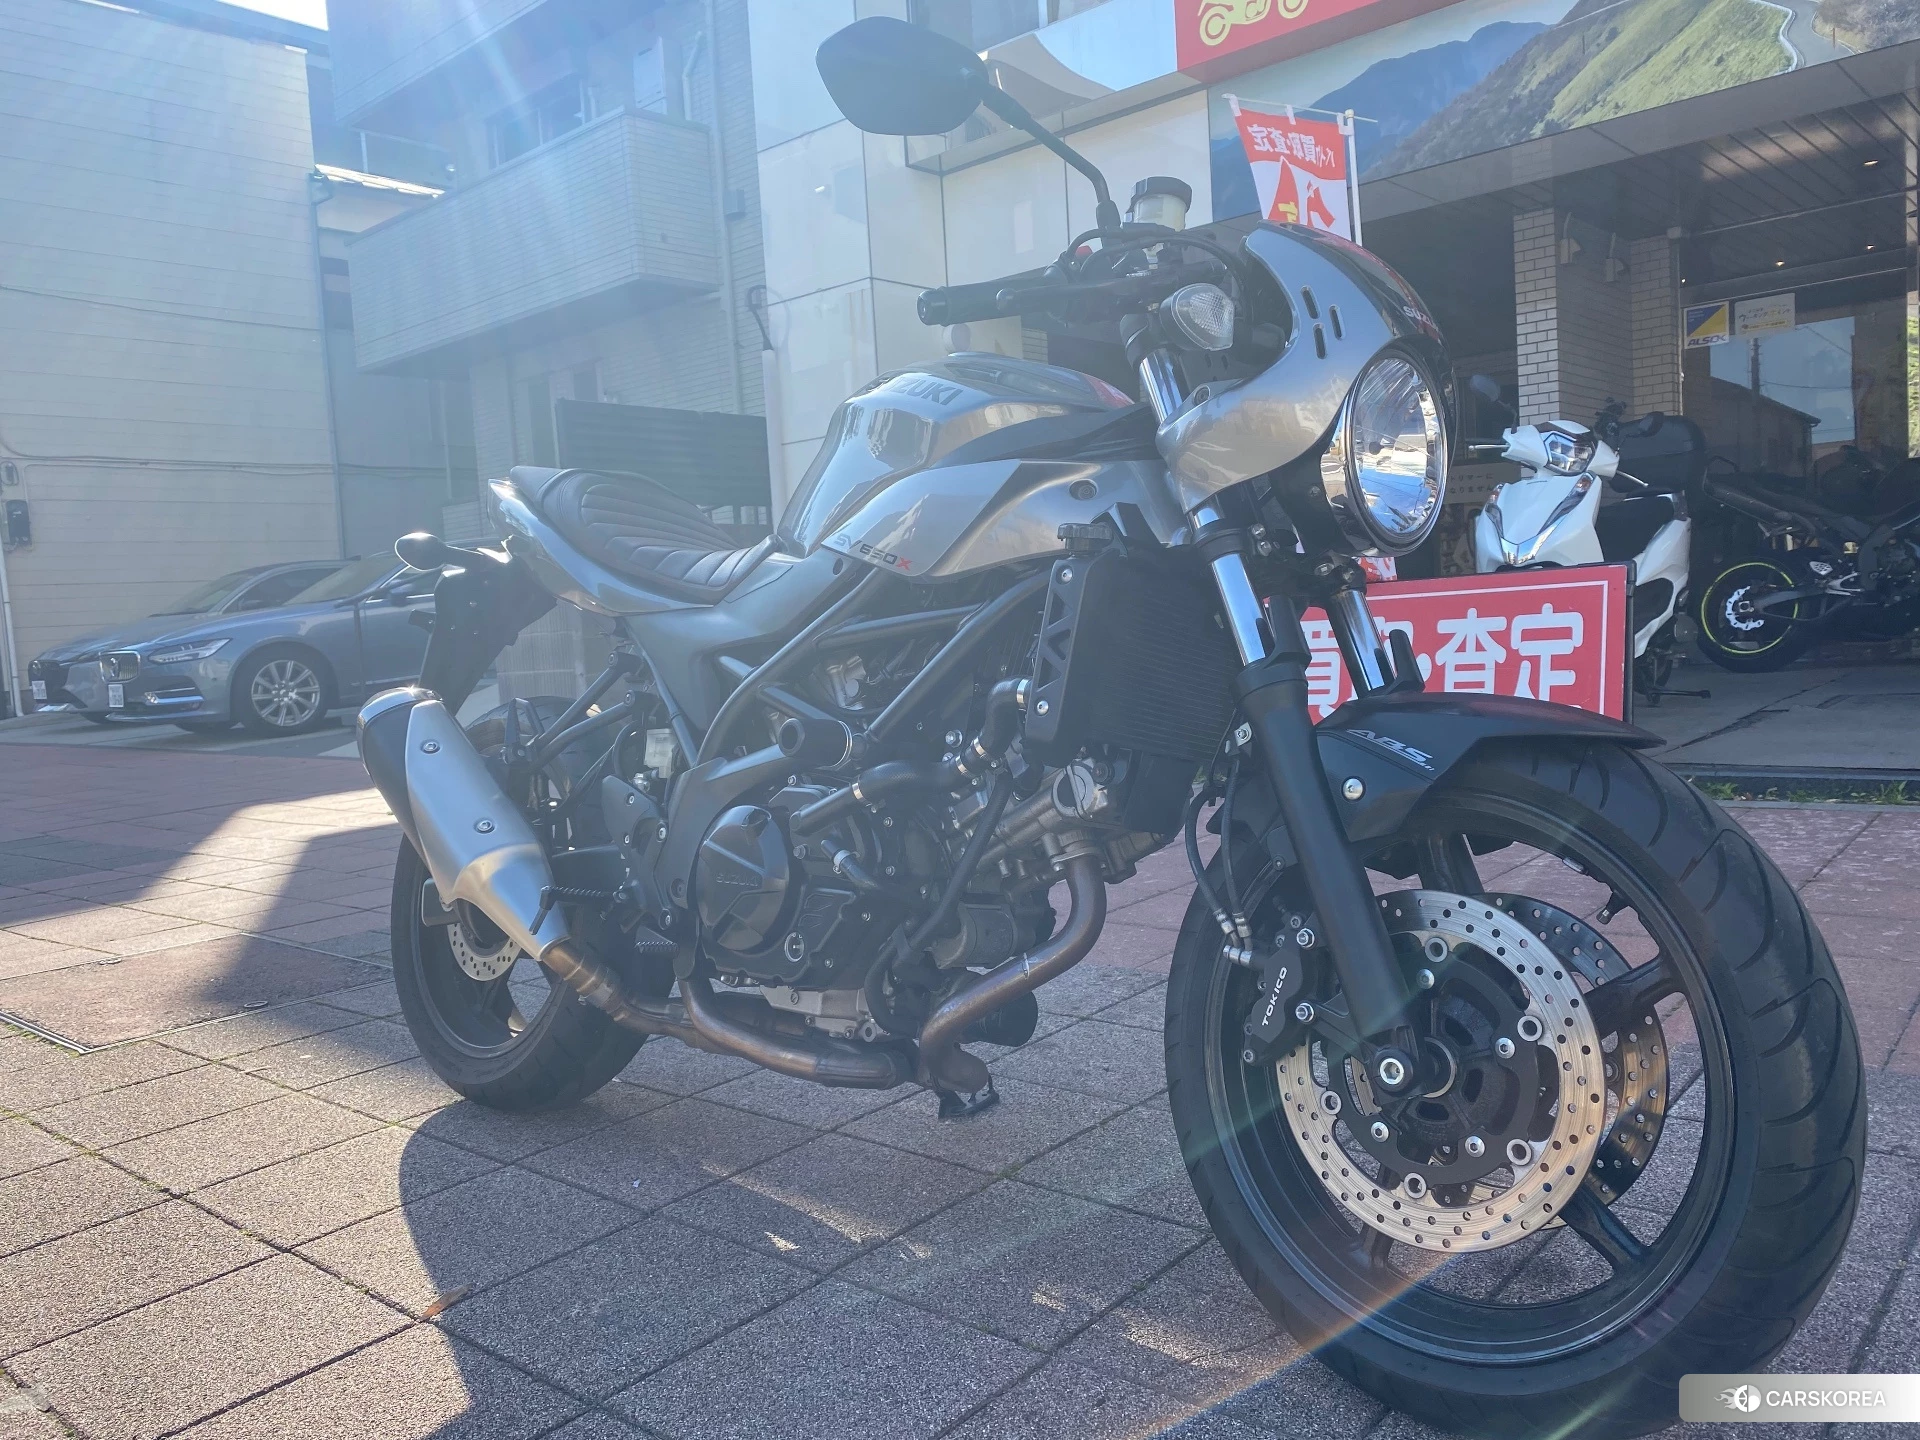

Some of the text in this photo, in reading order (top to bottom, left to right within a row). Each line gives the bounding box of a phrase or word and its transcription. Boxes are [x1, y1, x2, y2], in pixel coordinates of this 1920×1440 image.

[1687, 333, 1727, 347] ALSOK
[834, 533, 912, 571] SV650X
[1346, 729, 1434, 764] ABS
[716, 872, 759, 887] SUZUKI
[1261, 966, 1288, 1027] TOKICO
